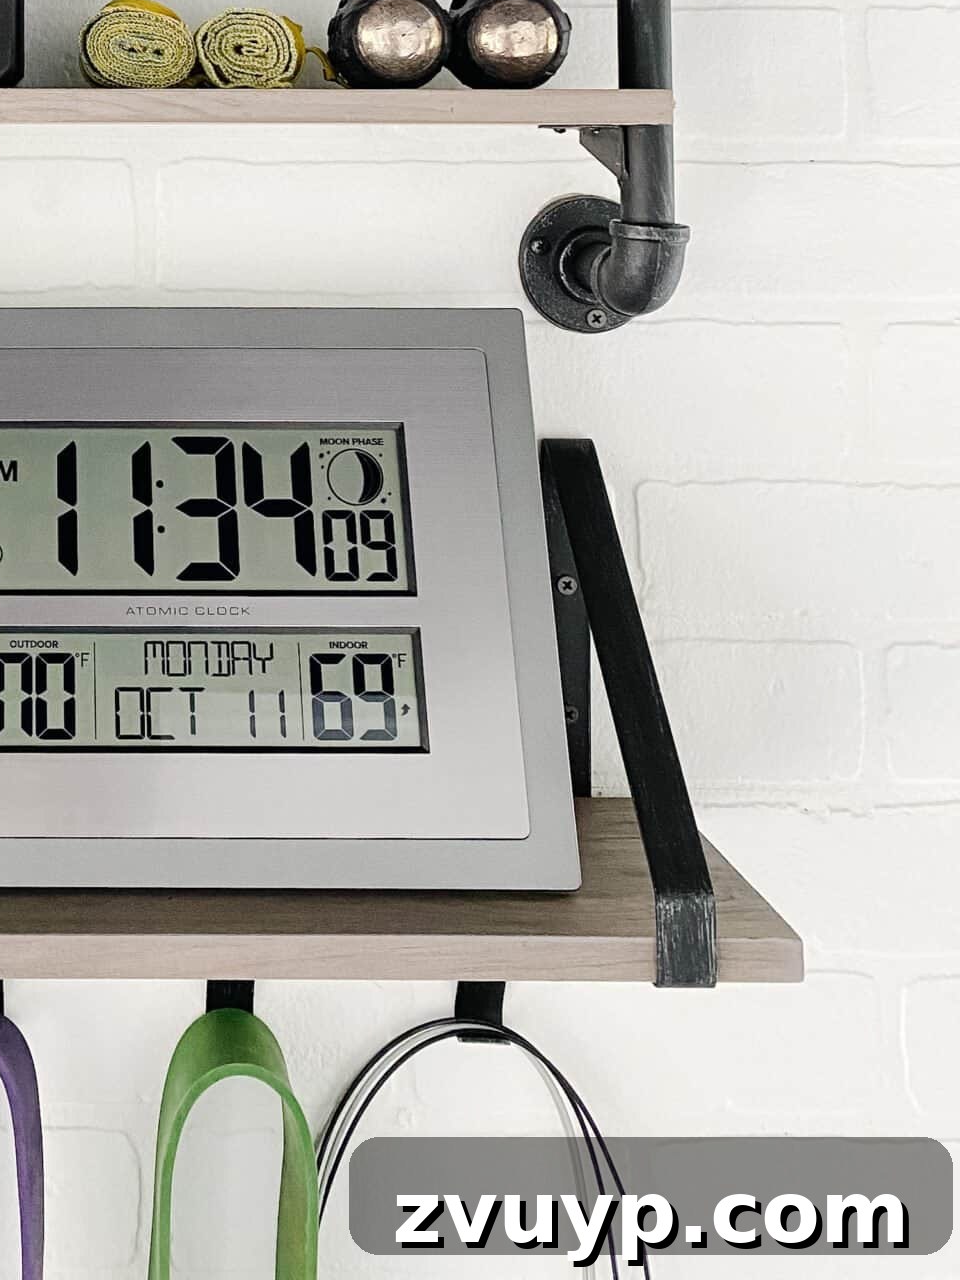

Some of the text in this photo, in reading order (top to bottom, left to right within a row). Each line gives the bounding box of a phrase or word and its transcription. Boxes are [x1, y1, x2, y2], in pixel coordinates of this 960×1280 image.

[320, 438, 384, 446] MOON PHASE
[56, 436, 317, 582] 11:34
[322, 509, 398, 582] 09
[126, 606, 251, 616] ATOMIC CLOCK
[9, 640, 59, 649] OUTDOOR
[328, 641, 368, 649] INDOOR
[144, 641, 274, 677] MONDAY
[115, 687, 287, 740] OCT 11
